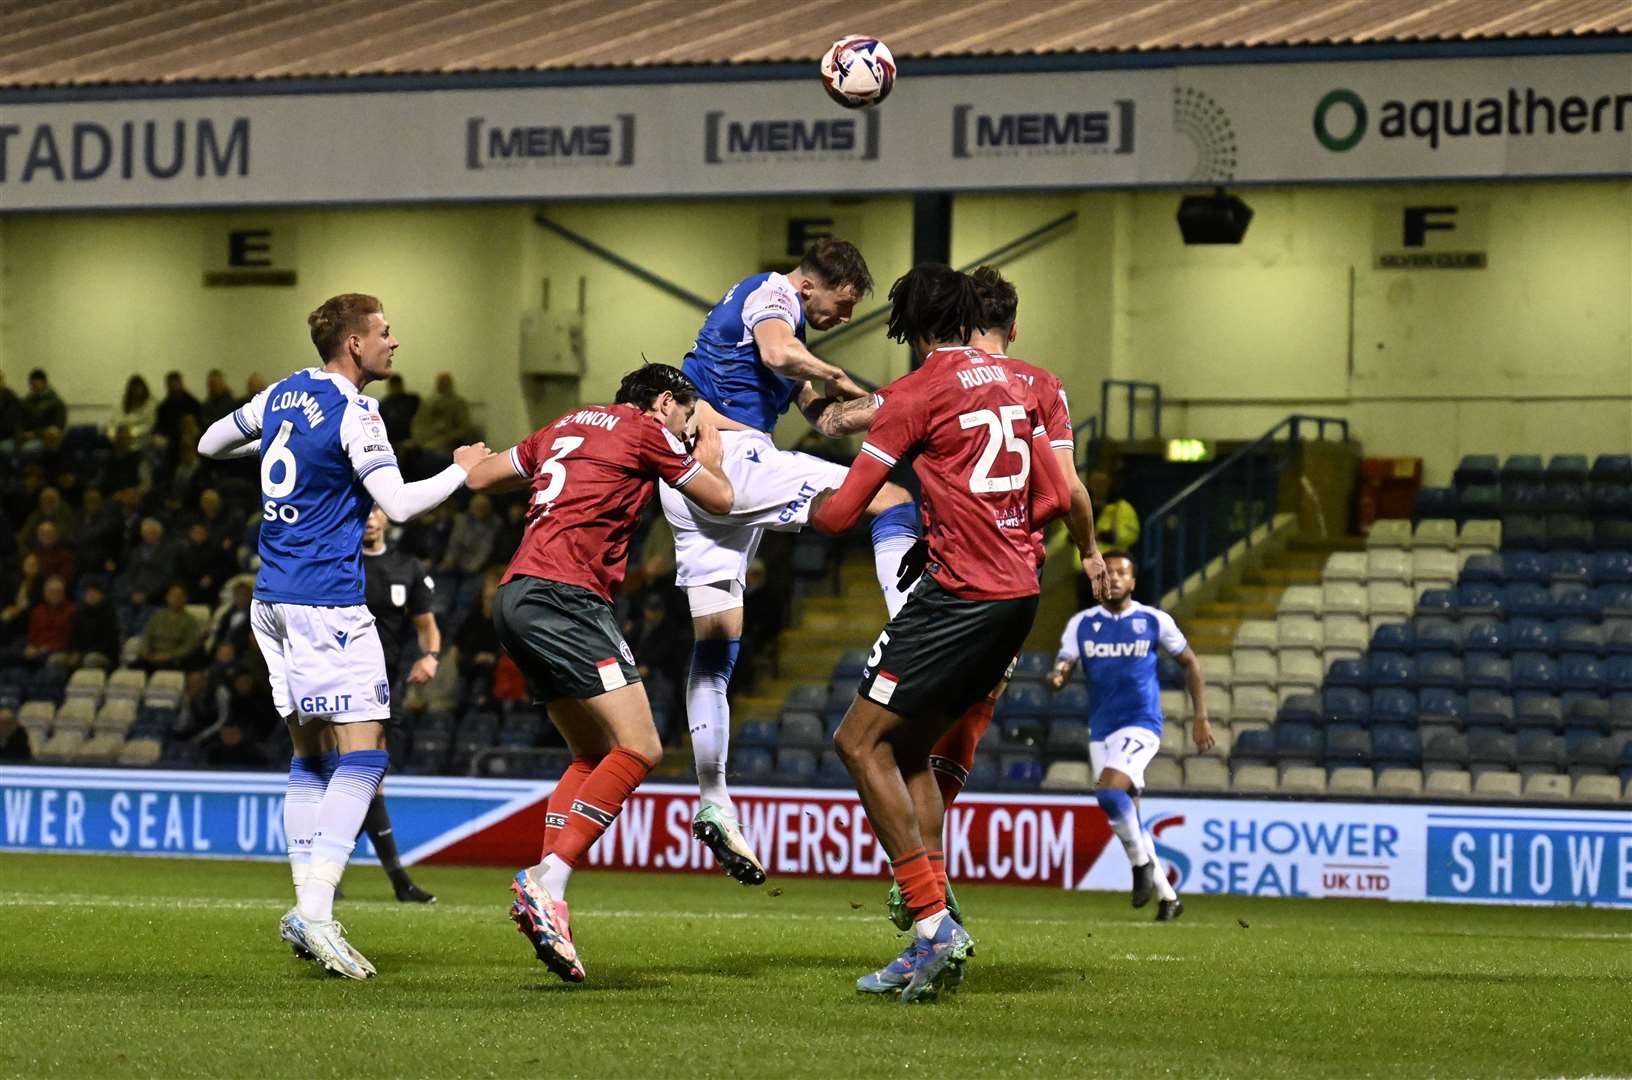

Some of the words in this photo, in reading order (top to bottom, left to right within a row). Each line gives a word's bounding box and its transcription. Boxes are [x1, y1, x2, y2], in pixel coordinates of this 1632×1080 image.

[1403, 206, 1459, 248] F
[228, 230, 273, 267] E
[261, 420, 297, 499] 6
[958, 405, 1031, 494] 25
[534, 436, 585, 505] 3
[263, 500, 299, 524] SO
[778, 480, 817, 523] GR.IT
[301, 695, 352, 713] GR.IT
[1120, 737, 1145, 755] 17
[109, 791, 211, 851] SEAL
[238, 796, 286, 852] UK
[1202, 818, 1398, 858] SHOWER
[1202, 861, 1310, 896] SEAL
[1322, 874, 1350, 890] UK
[1356, 874, 1390, 891] LTD
